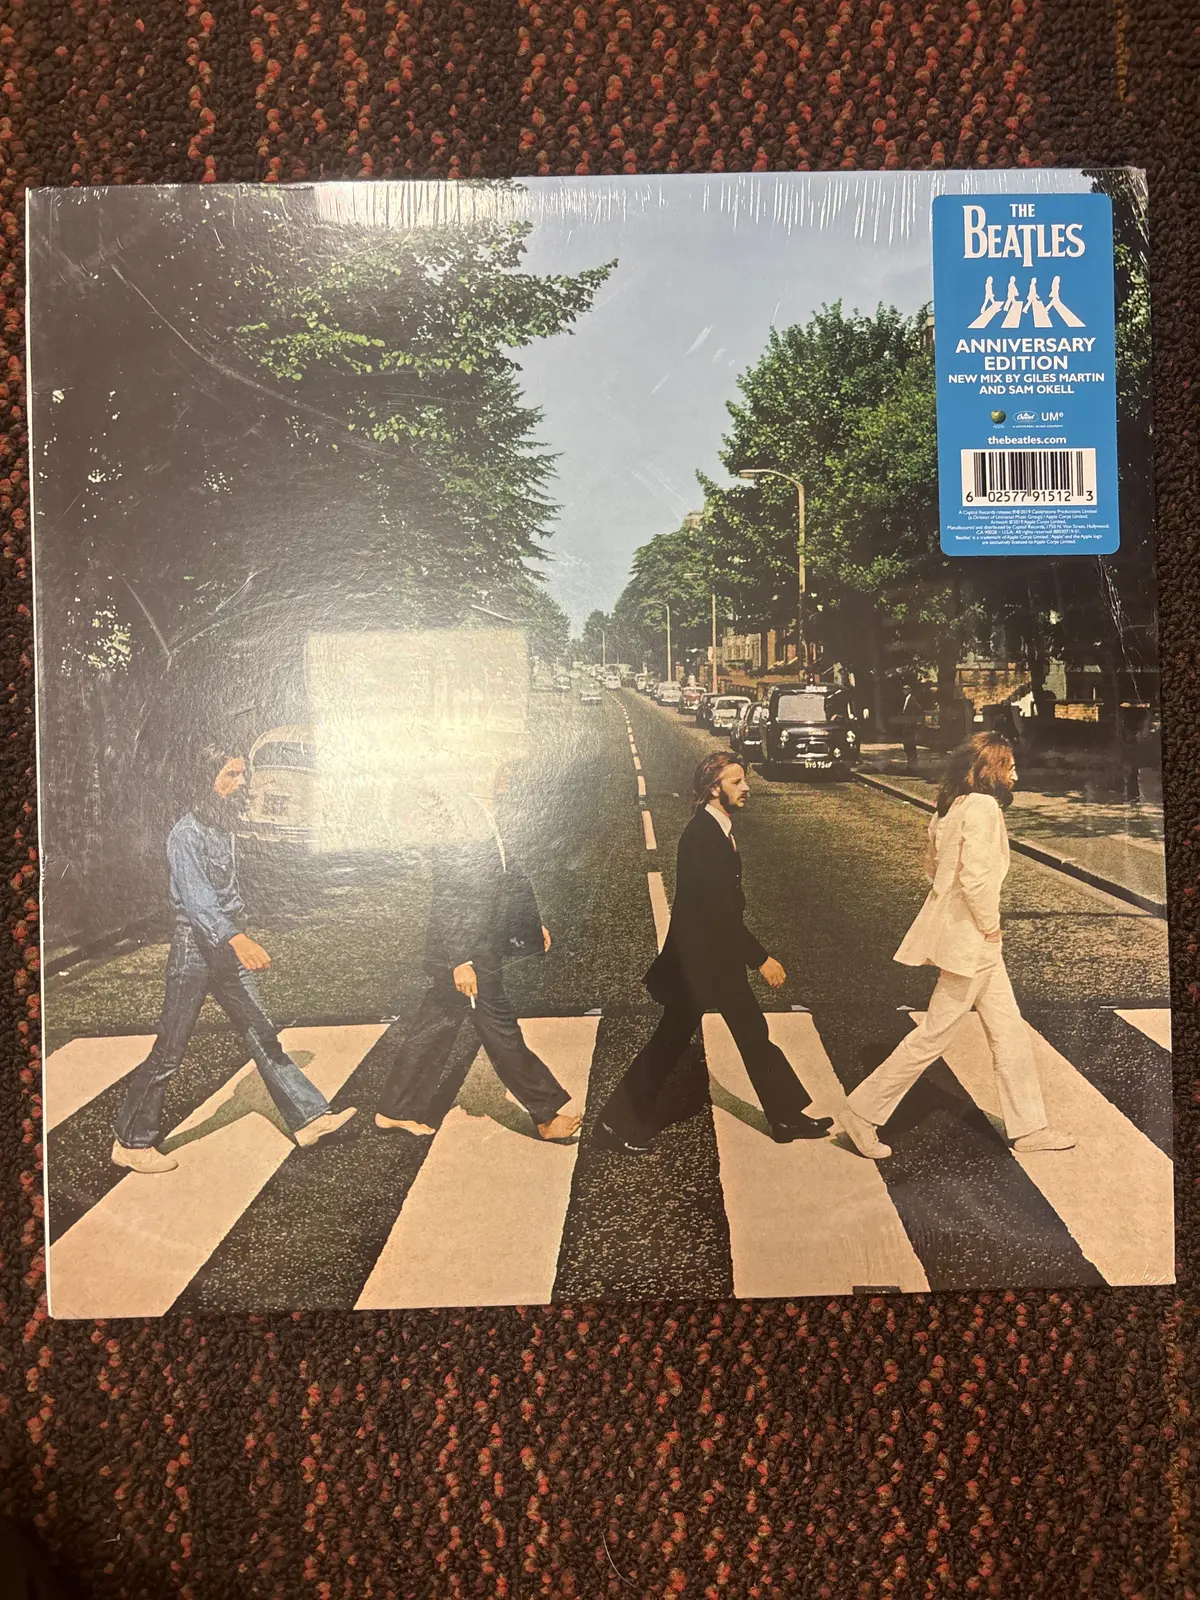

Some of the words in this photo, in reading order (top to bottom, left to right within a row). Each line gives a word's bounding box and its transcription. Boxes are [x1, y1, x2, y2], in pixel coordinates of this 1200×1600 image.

[1009, 204, 1035, 218] THE
[962, 205, 1086, 267] BEATLES
[955, 337, 1096, 353] ANNIVERSARY
[984, 355, 1068, 371] EDITION
[948, 374, 977, 383] NEW
[980, 374, 1003, 383] MIX
[1005, 374, 1021, 383] BY
[1024, 373, 1056, 383] GILES
[1059, 373, 1105, 383] MARTIN
[979, 385, 1006, 394] AND
[1009, 385, 1034, 394] SAM
[1036, 385, 1075, 394] OKELL
[988, 435, 1066, 445] thebeatles.com
[966, 492, 974, 502] 6
[988, 492, 1027, 502] 02577
[1032, 491, 1071, 502] 91512
[1086, 491, 1094, 502] 3
